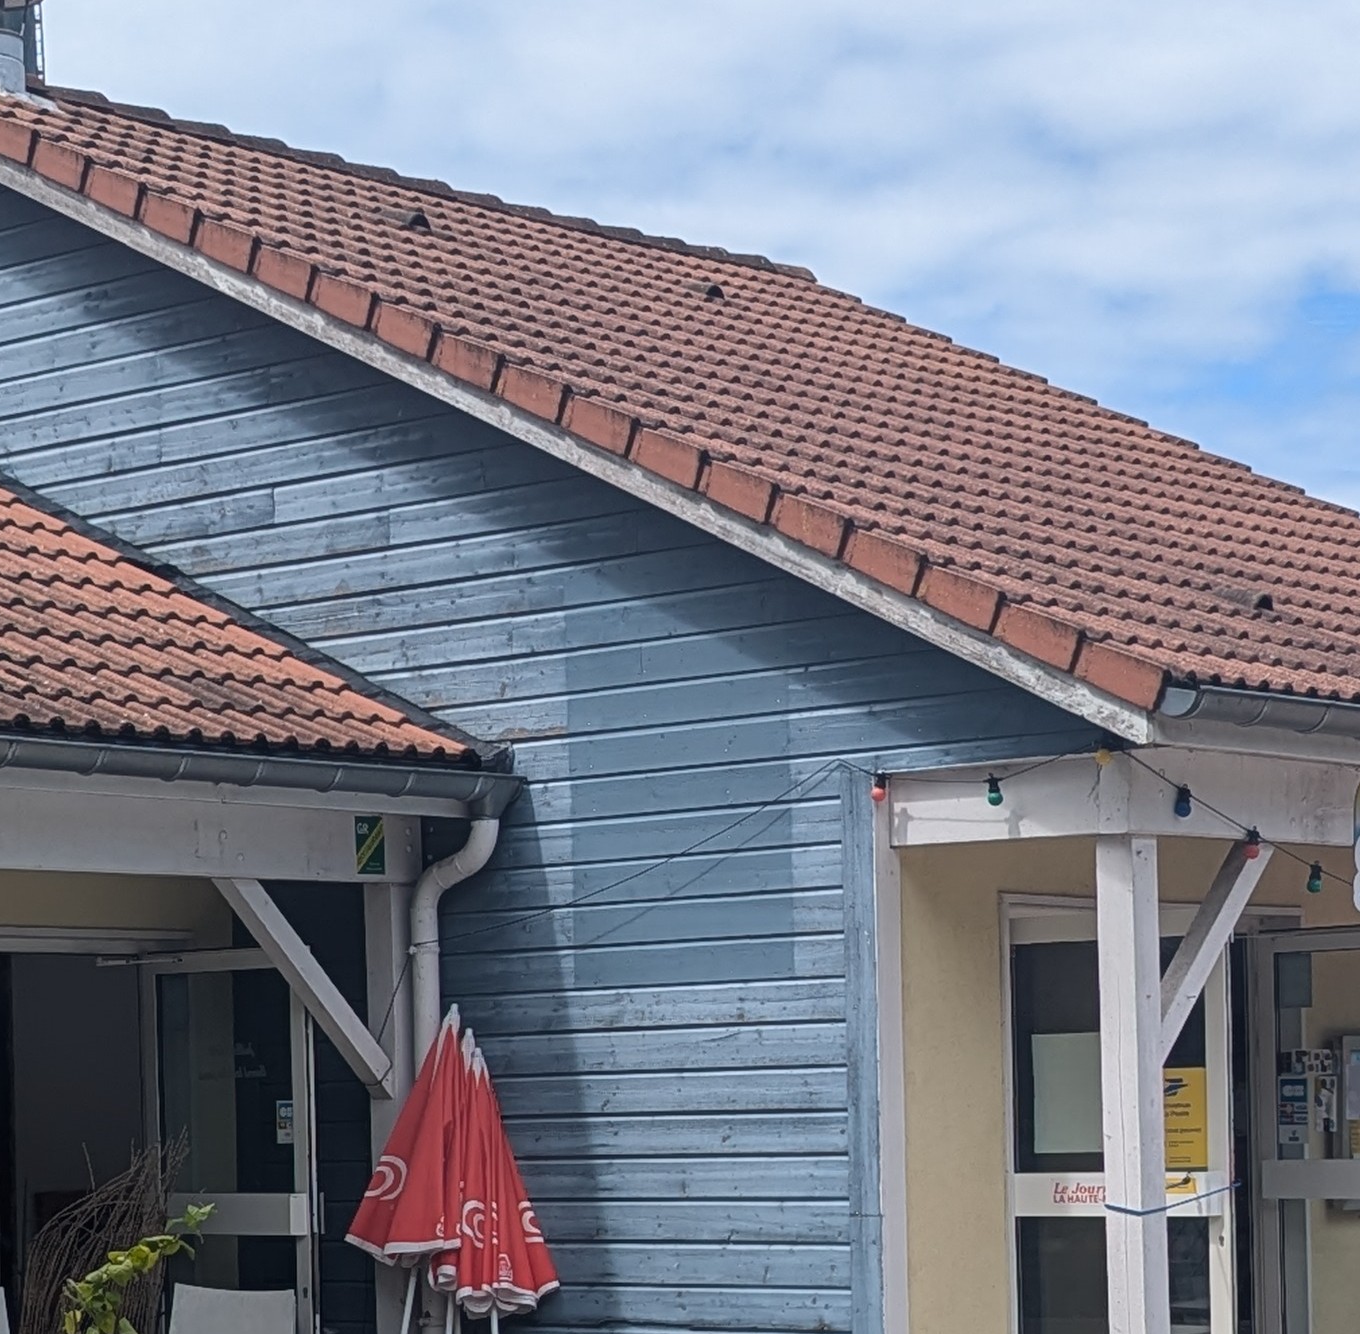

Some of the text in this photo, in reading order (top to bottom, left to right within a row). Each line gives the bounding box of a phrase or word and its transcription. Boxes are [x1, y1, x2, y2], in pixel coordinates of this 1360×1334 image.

[1054, 1182, 1106, 1195] Le Jour
[1053, 1194, 1106, 1204] LA HAUTE-
